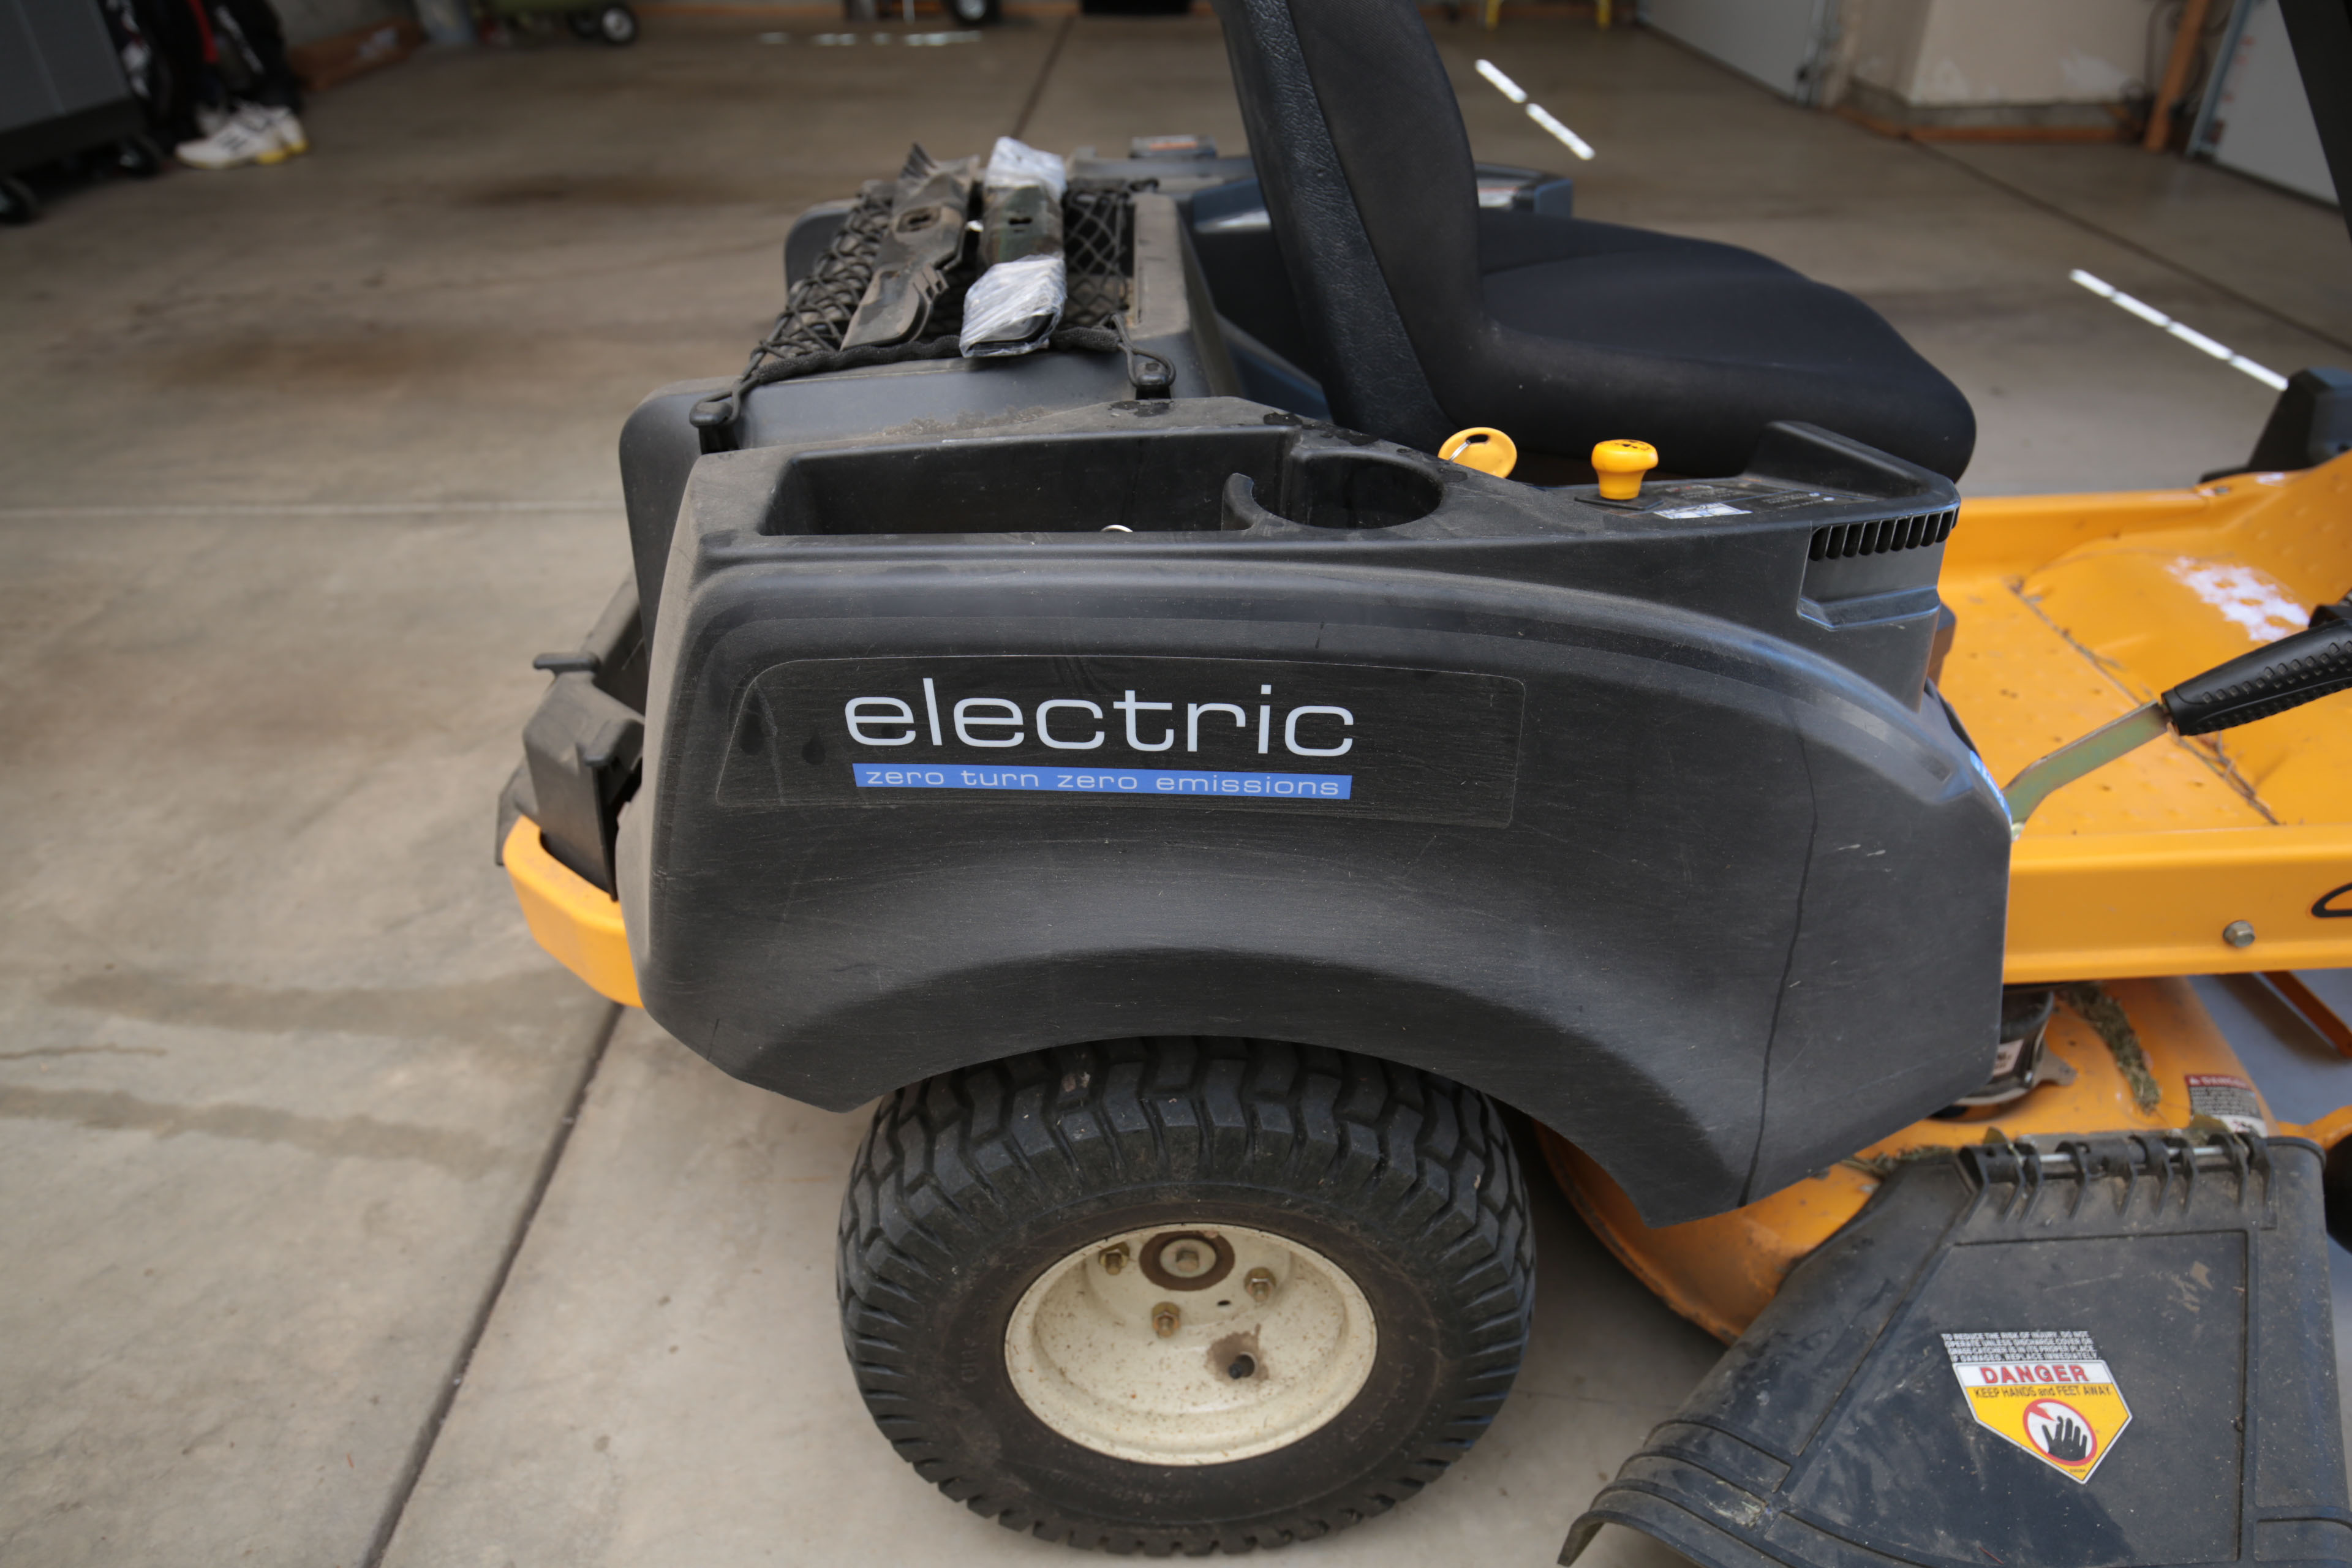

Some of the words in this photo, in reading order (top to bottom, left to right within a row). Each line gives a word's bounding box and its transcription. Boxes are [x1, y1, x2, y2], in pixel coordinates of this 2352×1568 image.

[845, 678, 1354, 756] electric
[865, 771, 945, 785] zero
[960, 769, 1039, 788] turn
[1057, 774, 1138, 790] zero
[1155, 775, 1340, 796] emissions
[1980, 1365, 2090, 1384] DANGER
[1973, 1386, 2000, 1398] KEEP
[2002, 1385, 2037, 1397] HANDS
[2038, 1386, 2056, 1396] and
[2056, 1385, 2080, 1396] FEET
